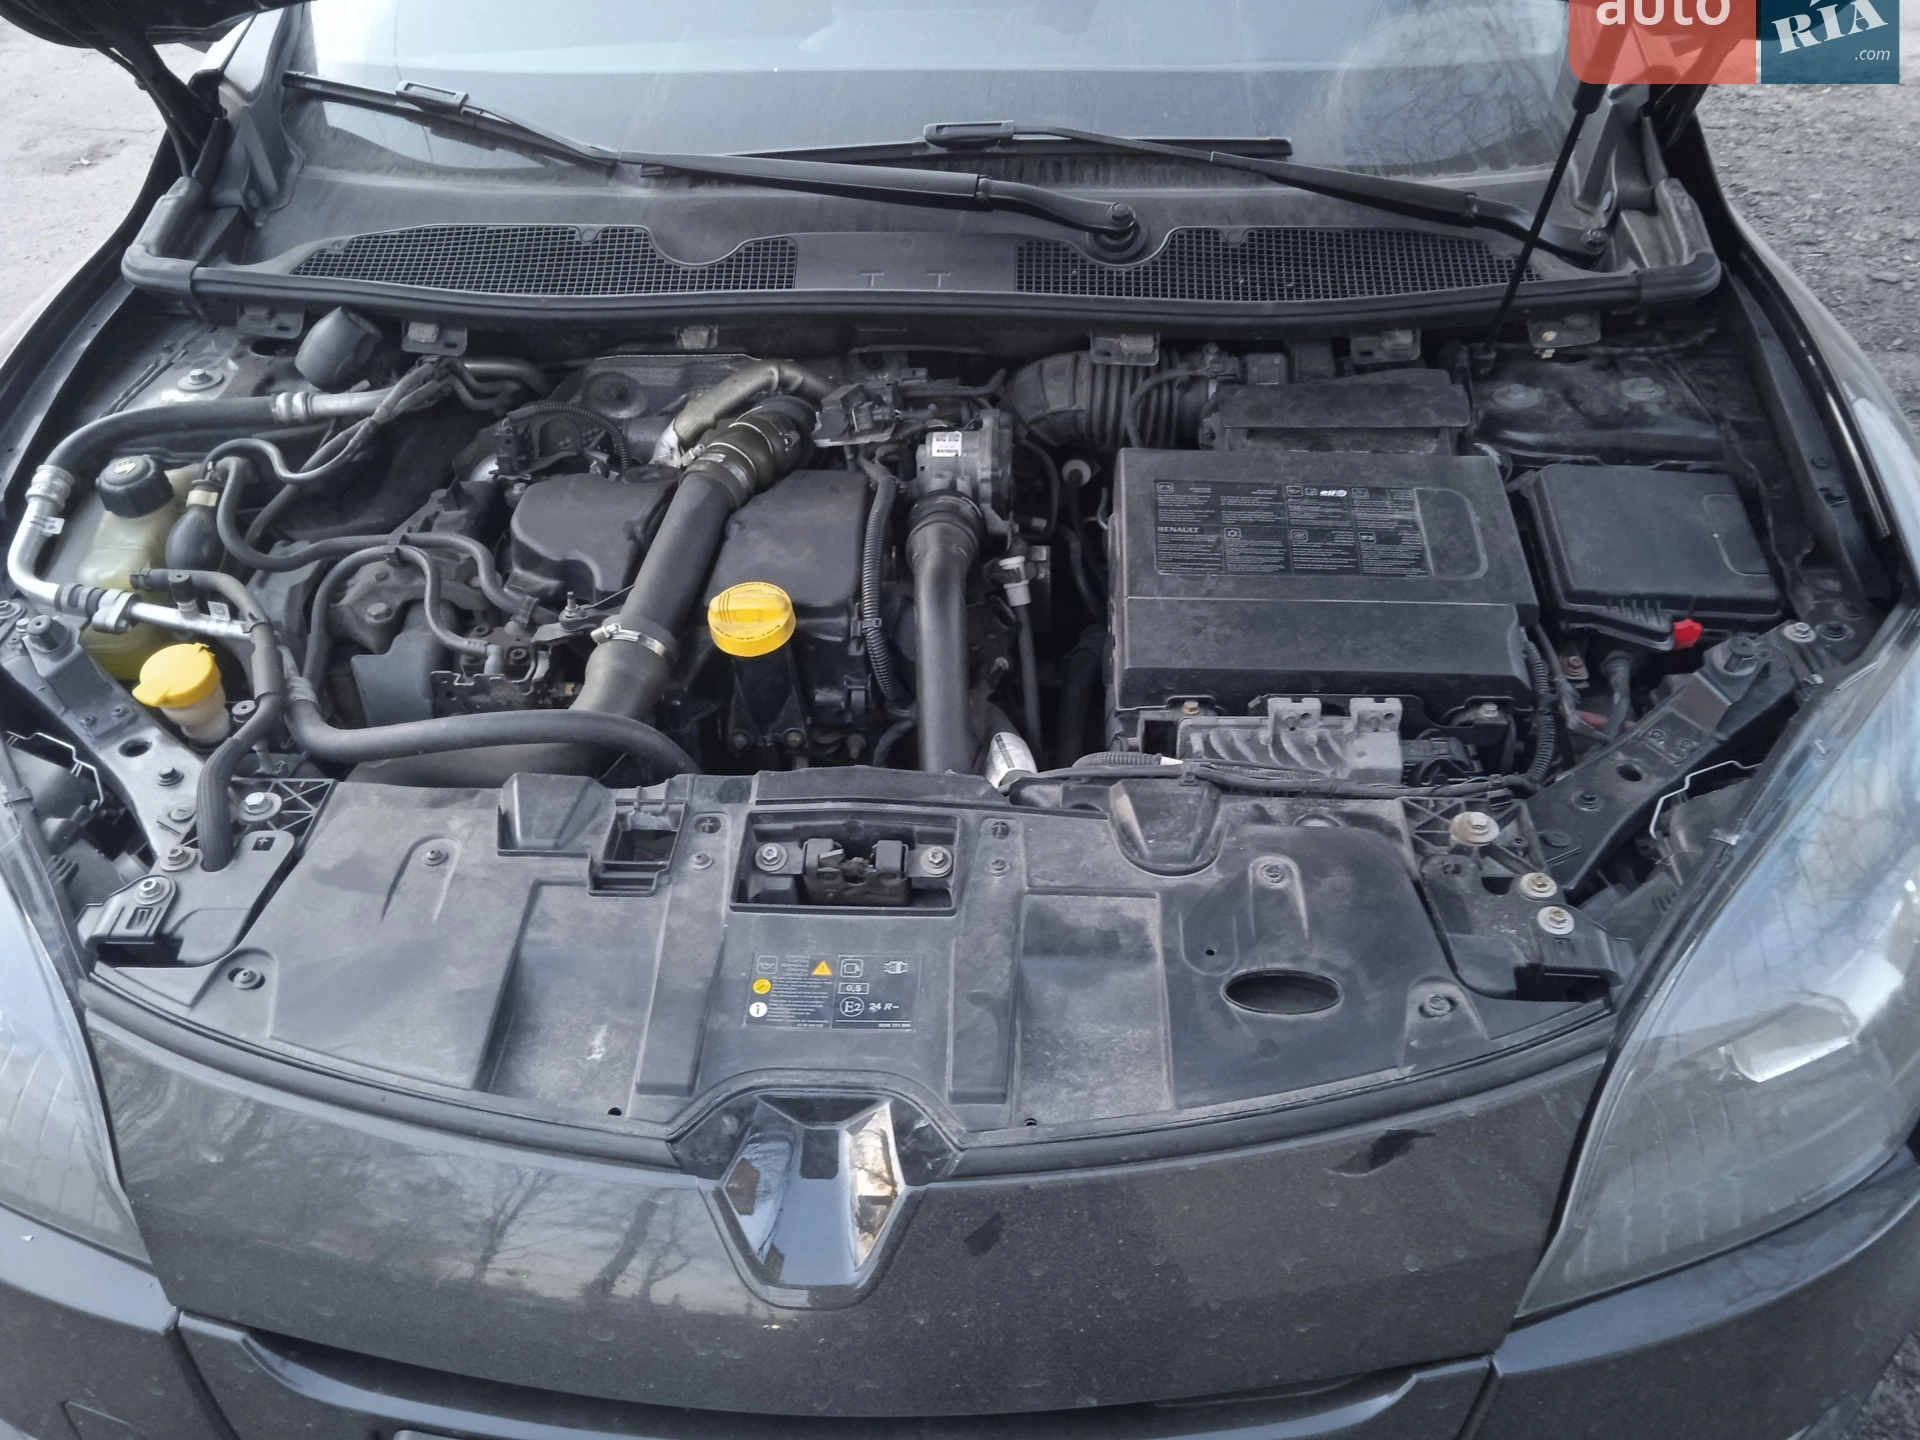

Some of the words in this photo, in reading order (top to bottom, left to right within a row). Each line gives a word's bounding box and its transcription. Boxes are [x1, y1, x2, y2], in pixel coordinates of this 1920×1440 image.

[846, 984, 861, 993] 0,5
[844, 1001, 862, 1012] E2
[869, 1002, 882, 1011] 24
